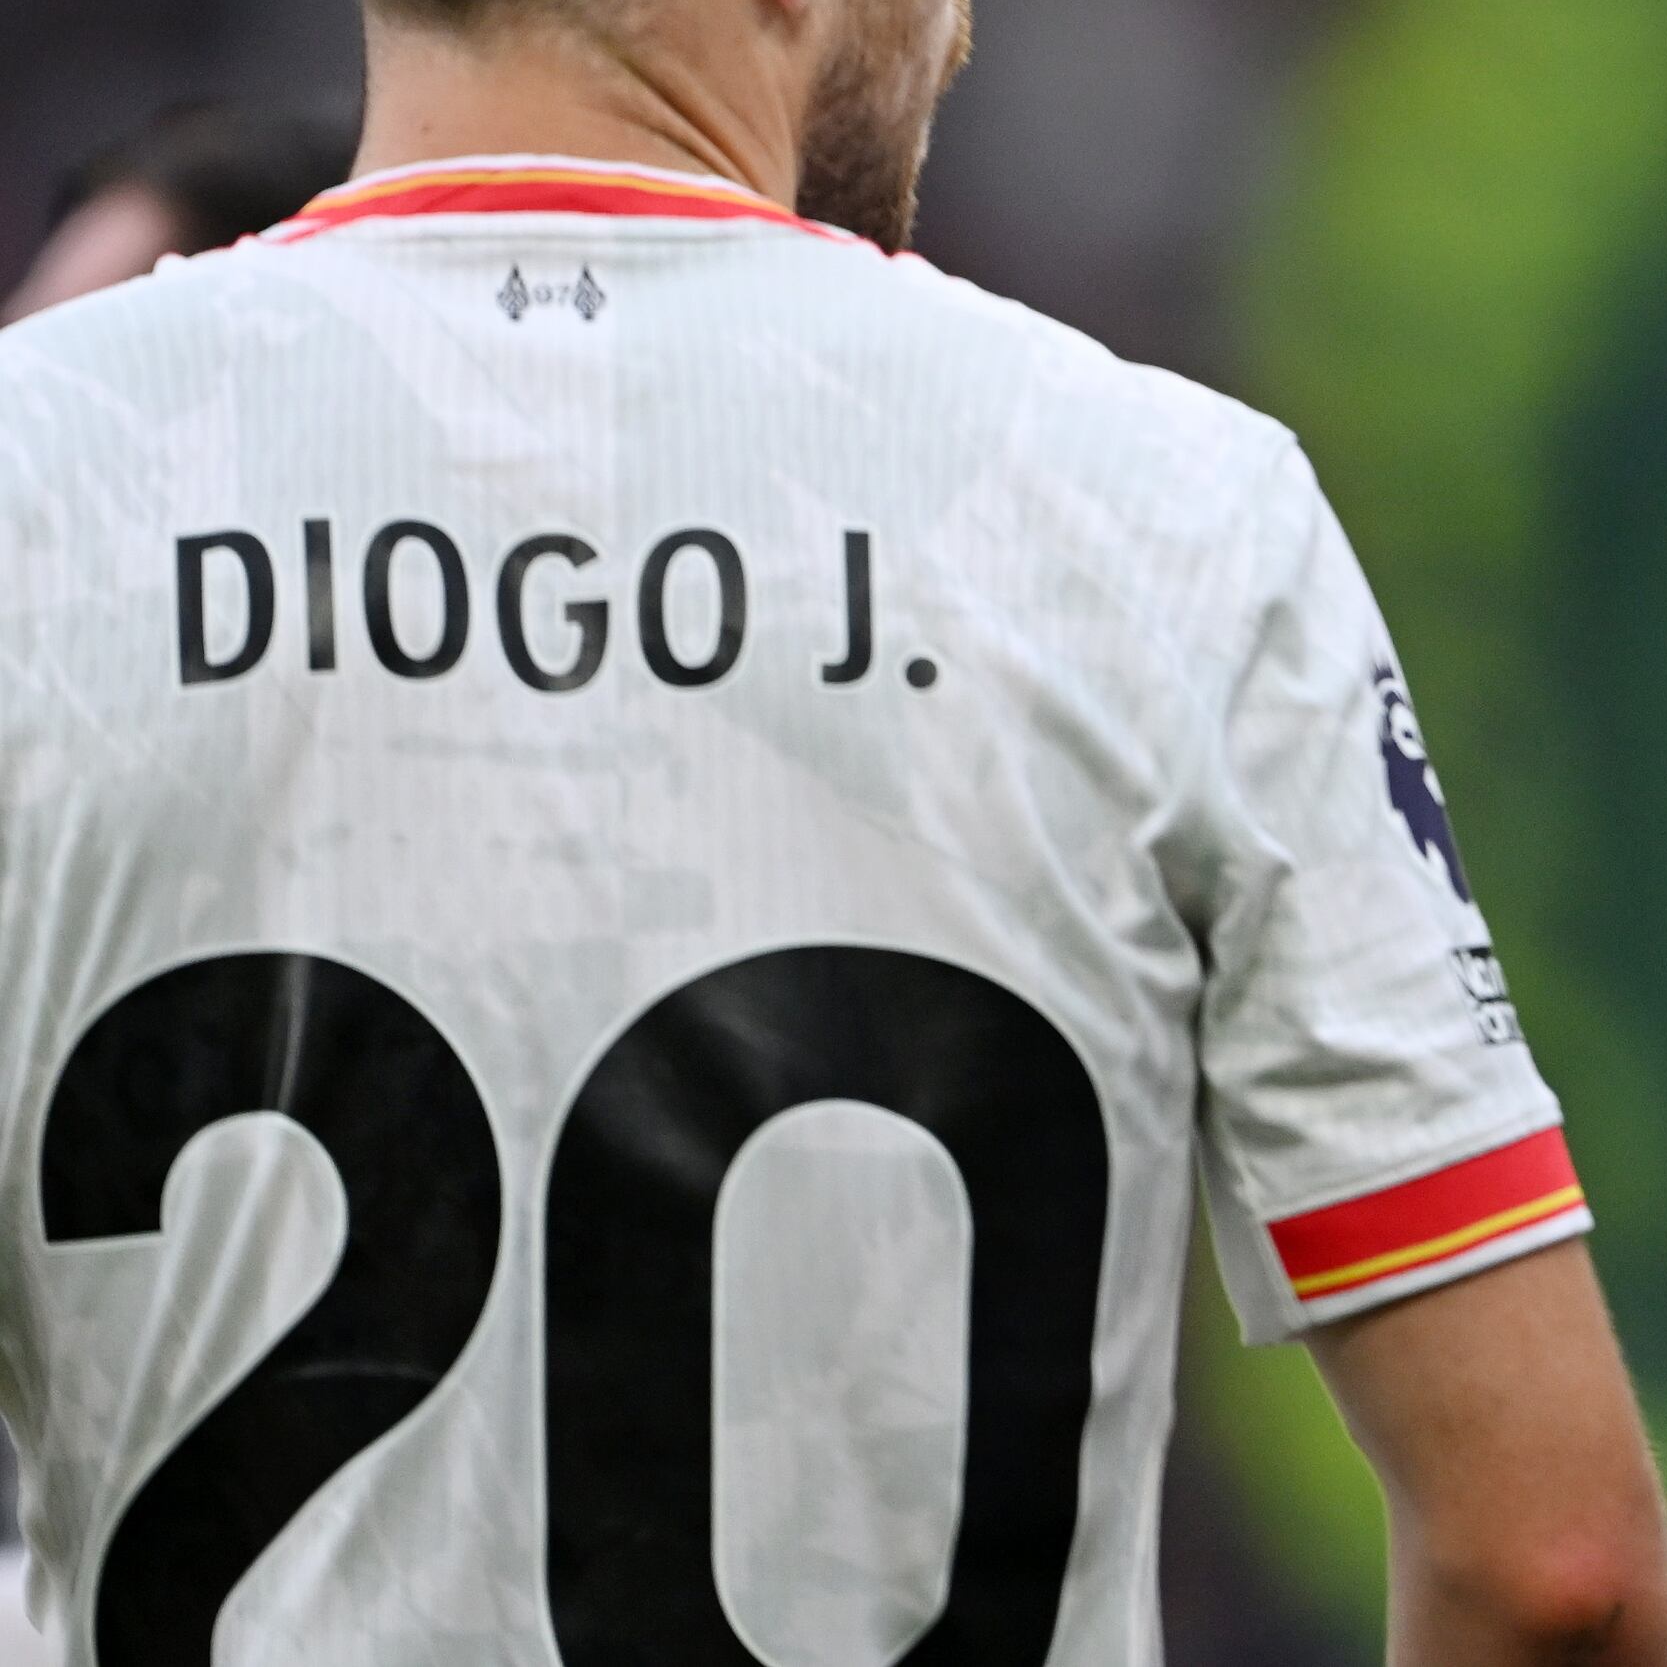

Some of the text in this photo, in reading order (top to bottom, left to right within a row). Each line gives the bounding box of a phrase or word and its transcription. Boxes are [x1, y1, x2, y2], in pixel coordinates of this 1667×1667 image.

[176, 518, 940, 692] DIOGO J.
[42, 943, 1110, 1667] 20
